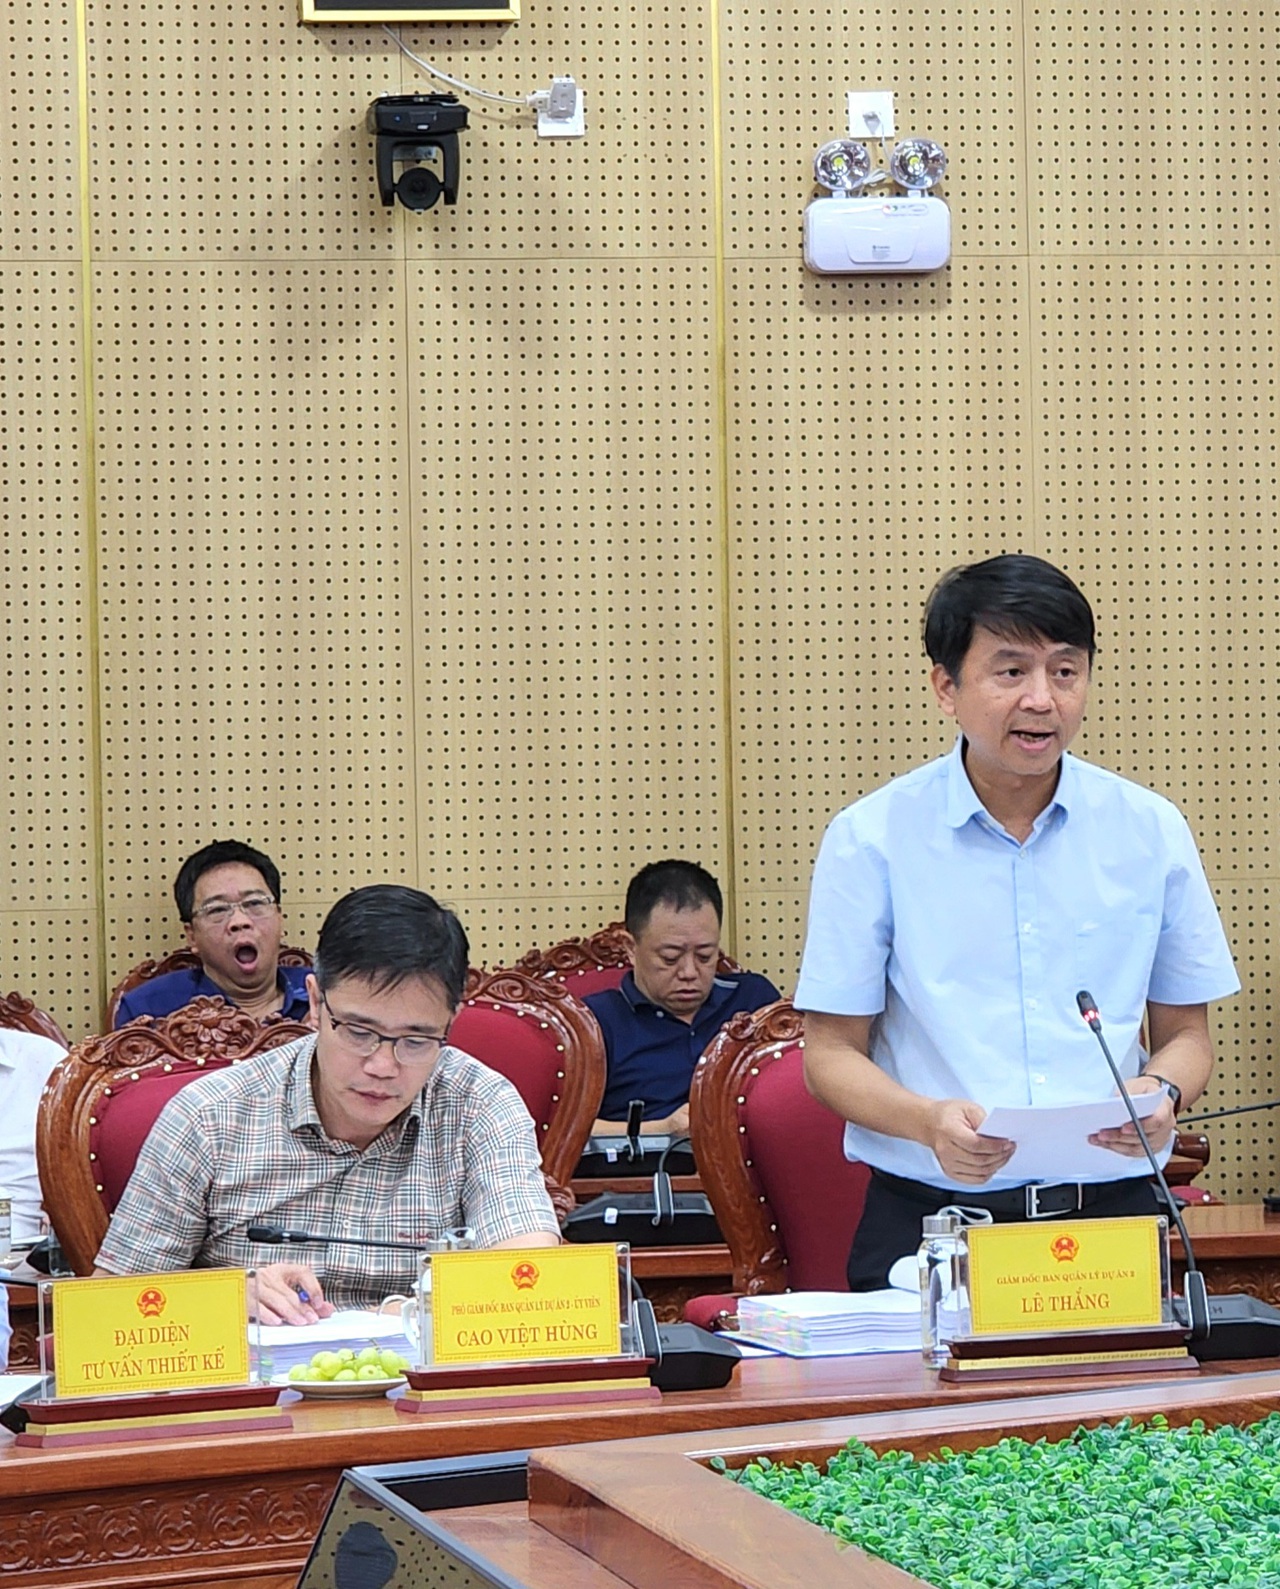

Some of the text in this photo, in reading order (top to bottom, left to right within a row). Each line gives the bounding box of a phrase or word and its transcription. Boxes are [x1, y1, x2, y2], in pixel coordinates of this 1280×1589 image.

[1021, 1286, 1110, 1313] LÊ THẮNG
[114, 1320, 190, 1350] ĐẠI DIỆN
[456, 1320, 598, 1348] CAO VIỆT HÙNG
[82, 1346, 225, 1380] TƯ VẤN THIẾT KẾ
